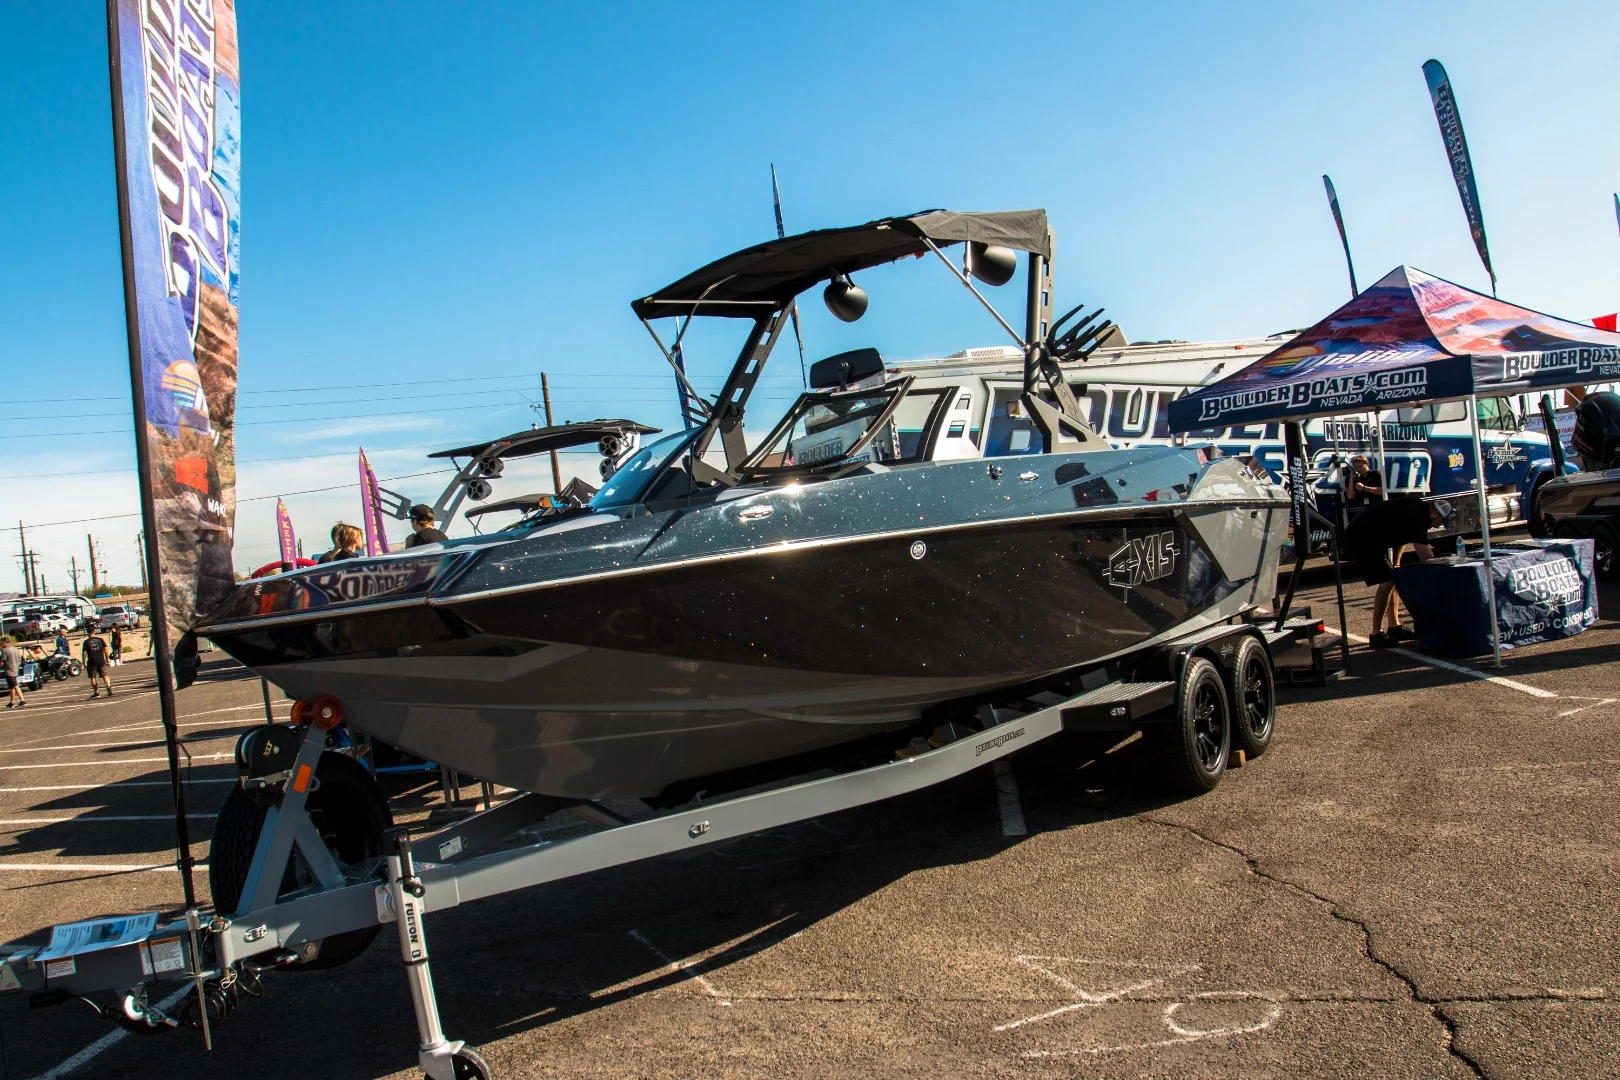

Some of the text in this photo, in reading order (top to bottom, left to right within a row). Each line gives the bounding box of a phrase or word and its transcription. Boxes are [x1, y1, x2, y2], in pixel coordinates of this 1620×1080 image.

[1503, 347, 1620, 381] BOULDERBOAT
[1320, 386, 1426, 408] NEVADA ARIZONA
[1325, 421, 1427, 441] NEVADA ARIZONA
[282, 520, 294, 563] KETTL
[1107, 530, 1176, 589] AXIS
[1519, 621, 1545, 636] USED
[405, 902, 419, 944] FULTON
